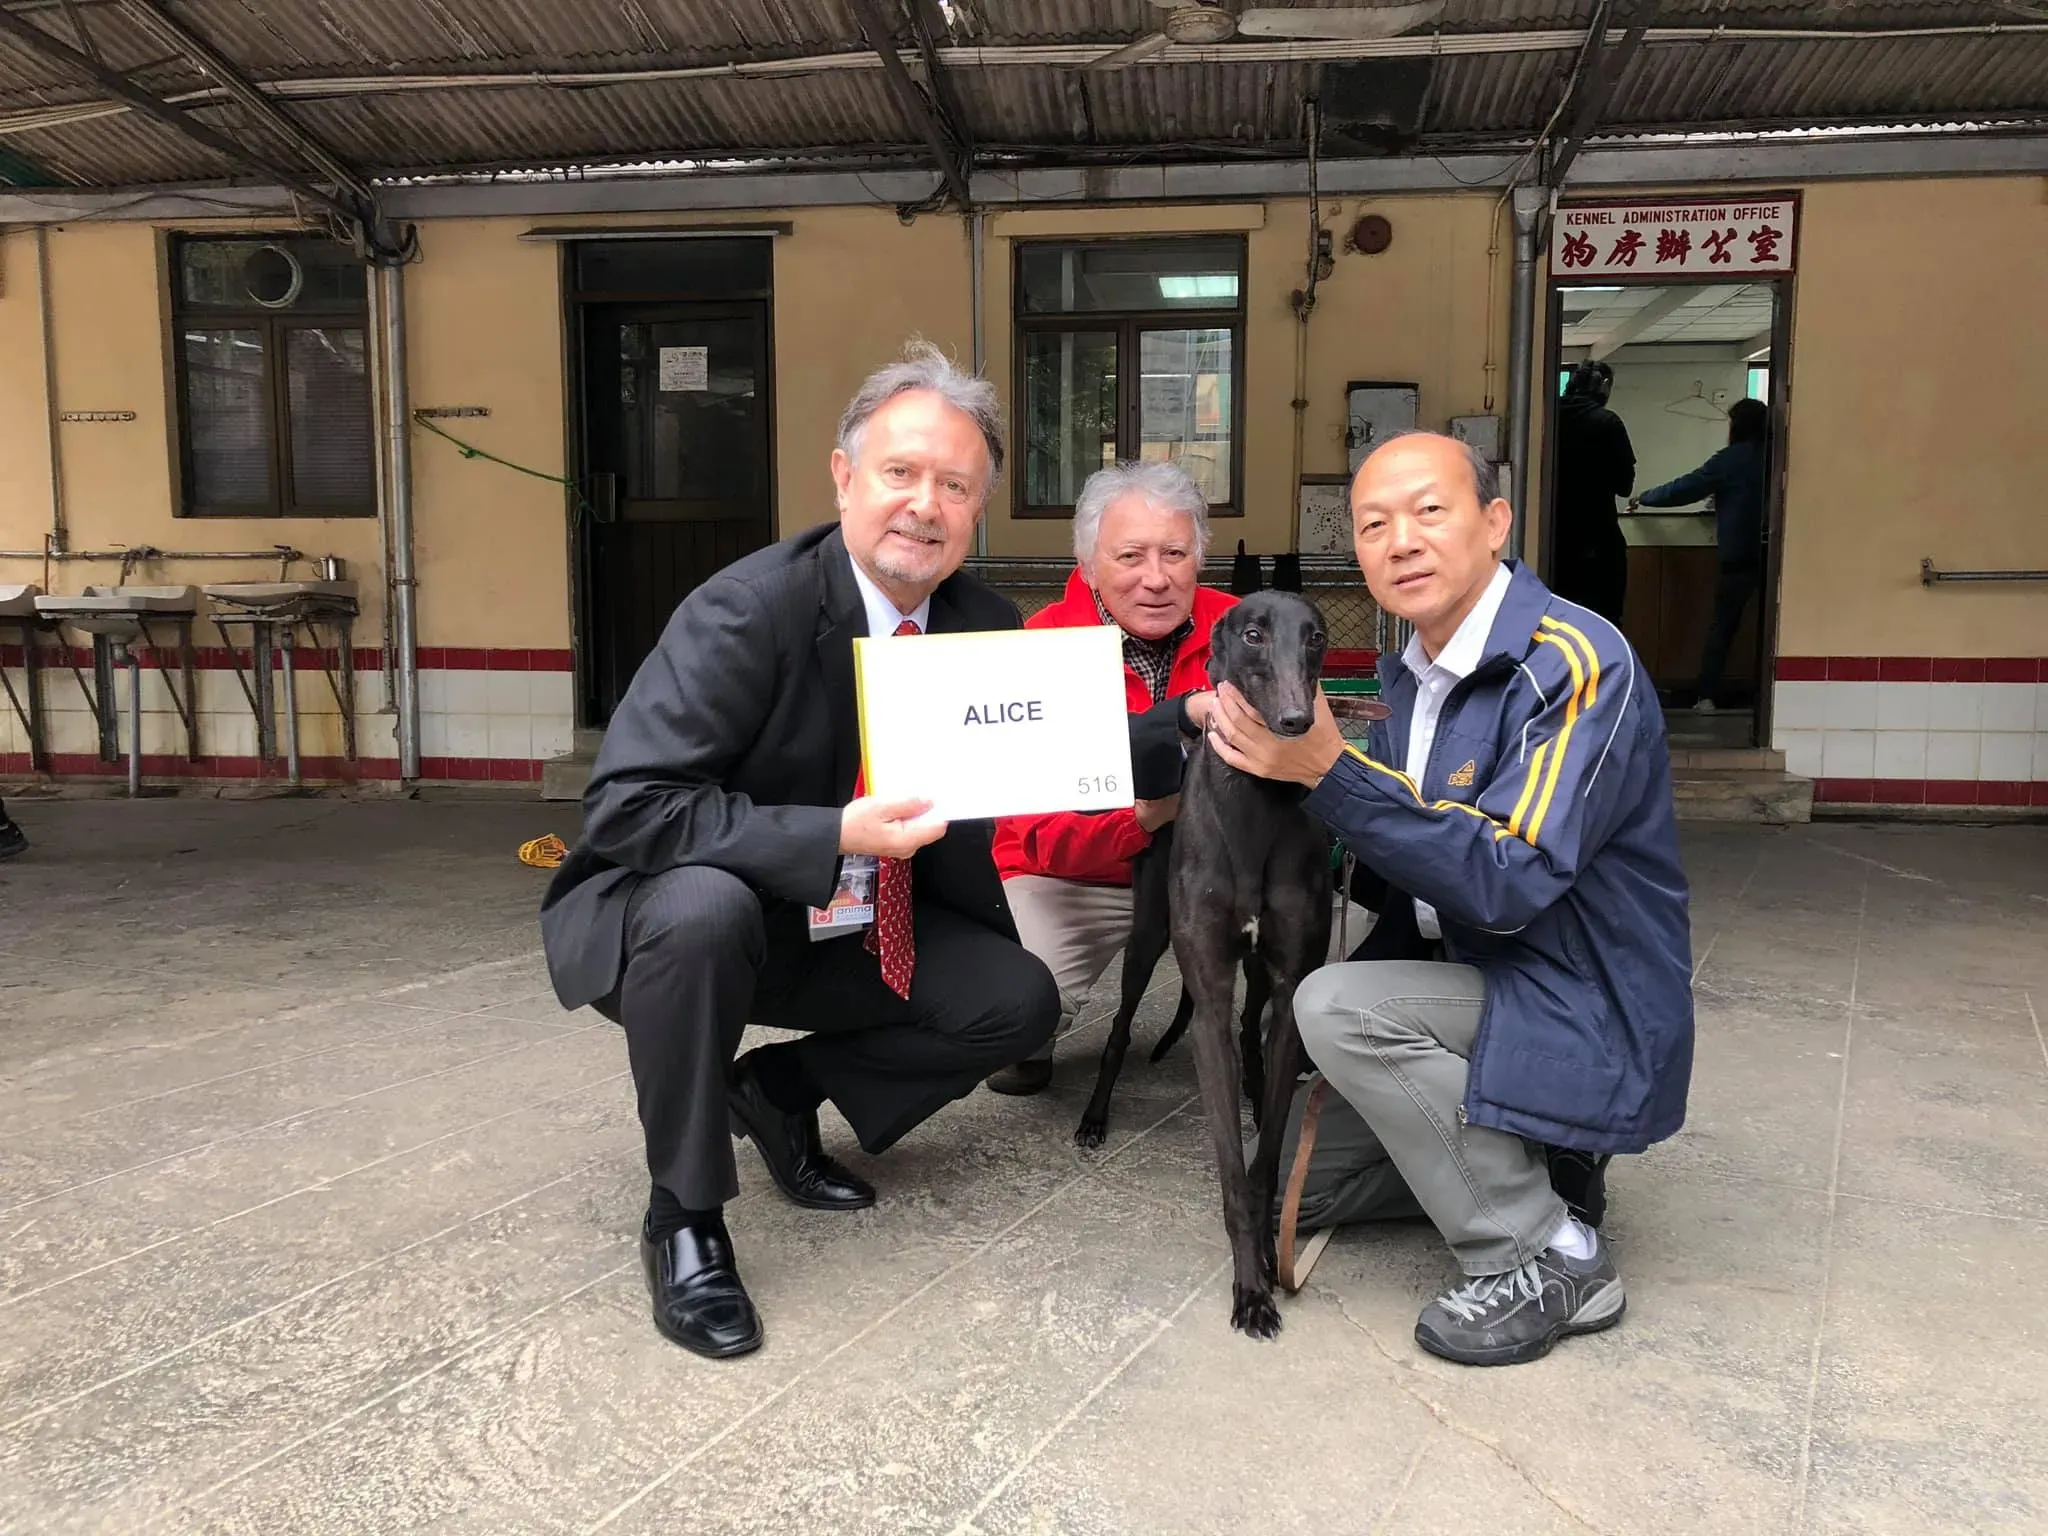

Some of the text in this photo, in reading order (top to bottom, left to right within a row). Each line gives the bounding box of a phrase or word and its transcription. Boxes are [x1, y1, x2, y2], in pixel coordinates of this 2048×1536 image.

[1566, 206, 1781, 226] KENNEL ADMINISTRATION OFFICE
[963, 700, 1044, 726] ALICE
[1077, 774, 1118, 795] 516
[836, 905, 872, 915] anima
